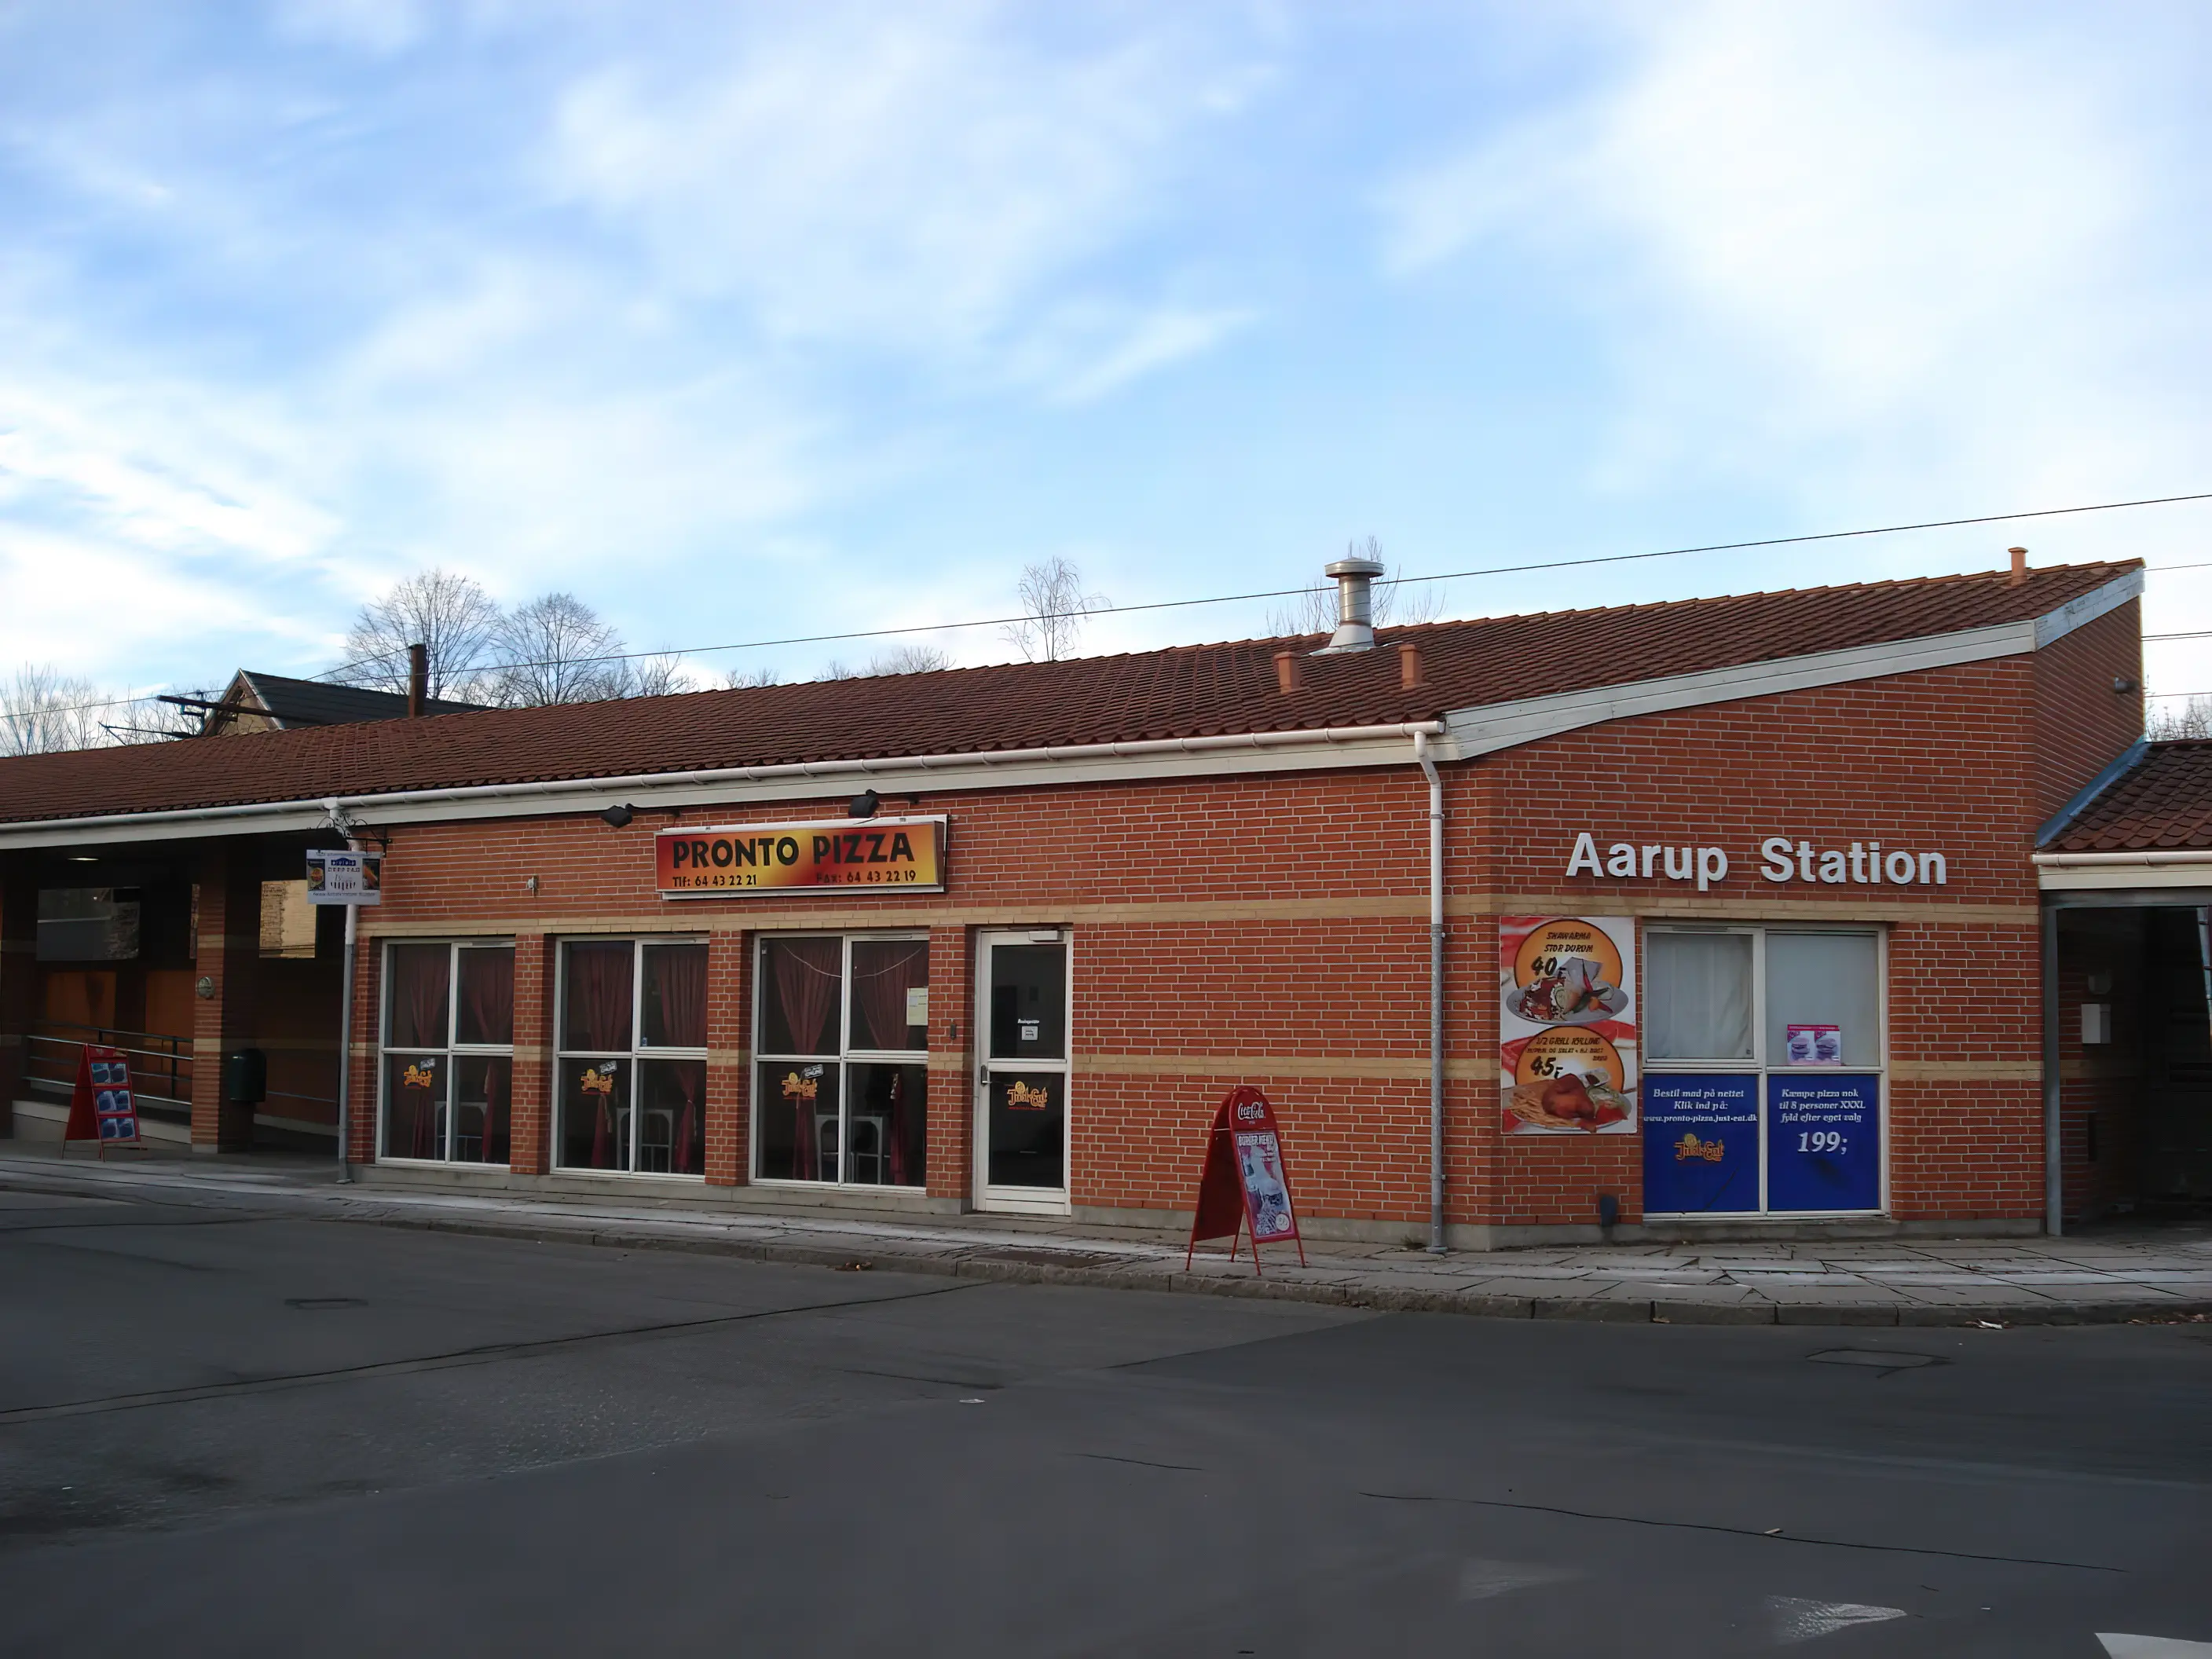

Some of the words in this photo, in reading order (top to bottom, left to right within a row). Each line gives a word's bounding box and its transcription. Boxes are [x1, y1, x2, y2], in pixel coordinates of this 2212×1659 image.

[672, 837, 800, 869] PRONTO
[812, 832, 915, 865] PIZZA
[1565, 832, 1728, 892] Aarup
[1760, 836, 1947, 885] Station
[672, 876, 690, 888] Tlf:
[695, 875, 708, 886] 64
[712, 875, 725, 886] 43
[729, 874, 742, 886] 22
[746, 874, 756, 885] 21
[816, 872, 842, 884] Fax:
[847, 870, 861, 882] 64
[866, 870, 881, 882] 43
[886, 870, 900, 882] 22
[904, 870, 916, 881] 19
[1544, 944, 1563, 953] STOR
[1653, 1089, 1680, 1097] Bestil
[1682, 1089, 1701, 1097] mad
[1704, 1089, 1716, 1099] på
[1817, 1090, 1840, 1099] pizza
[1842, 1089, 1859, 1097] nok
[1674, 1101, 1694, 1109] Klik
[1696, 1101, 1711, 1109] ind
[1779, 1101, 1789, 1109] til
[1790, 1101, 1797, 1109] 8
[1799, 1102, 1839, 1111] personer
[1840, 1101, 1866, 1109] XXXL
[1780, 1113, 1799, 1123] fyld
[1800, 1113, 1822, 1122] efter
[1822, 1114, 1842, 1123] eget
[1844, 1112, 1862, 1123] valg
